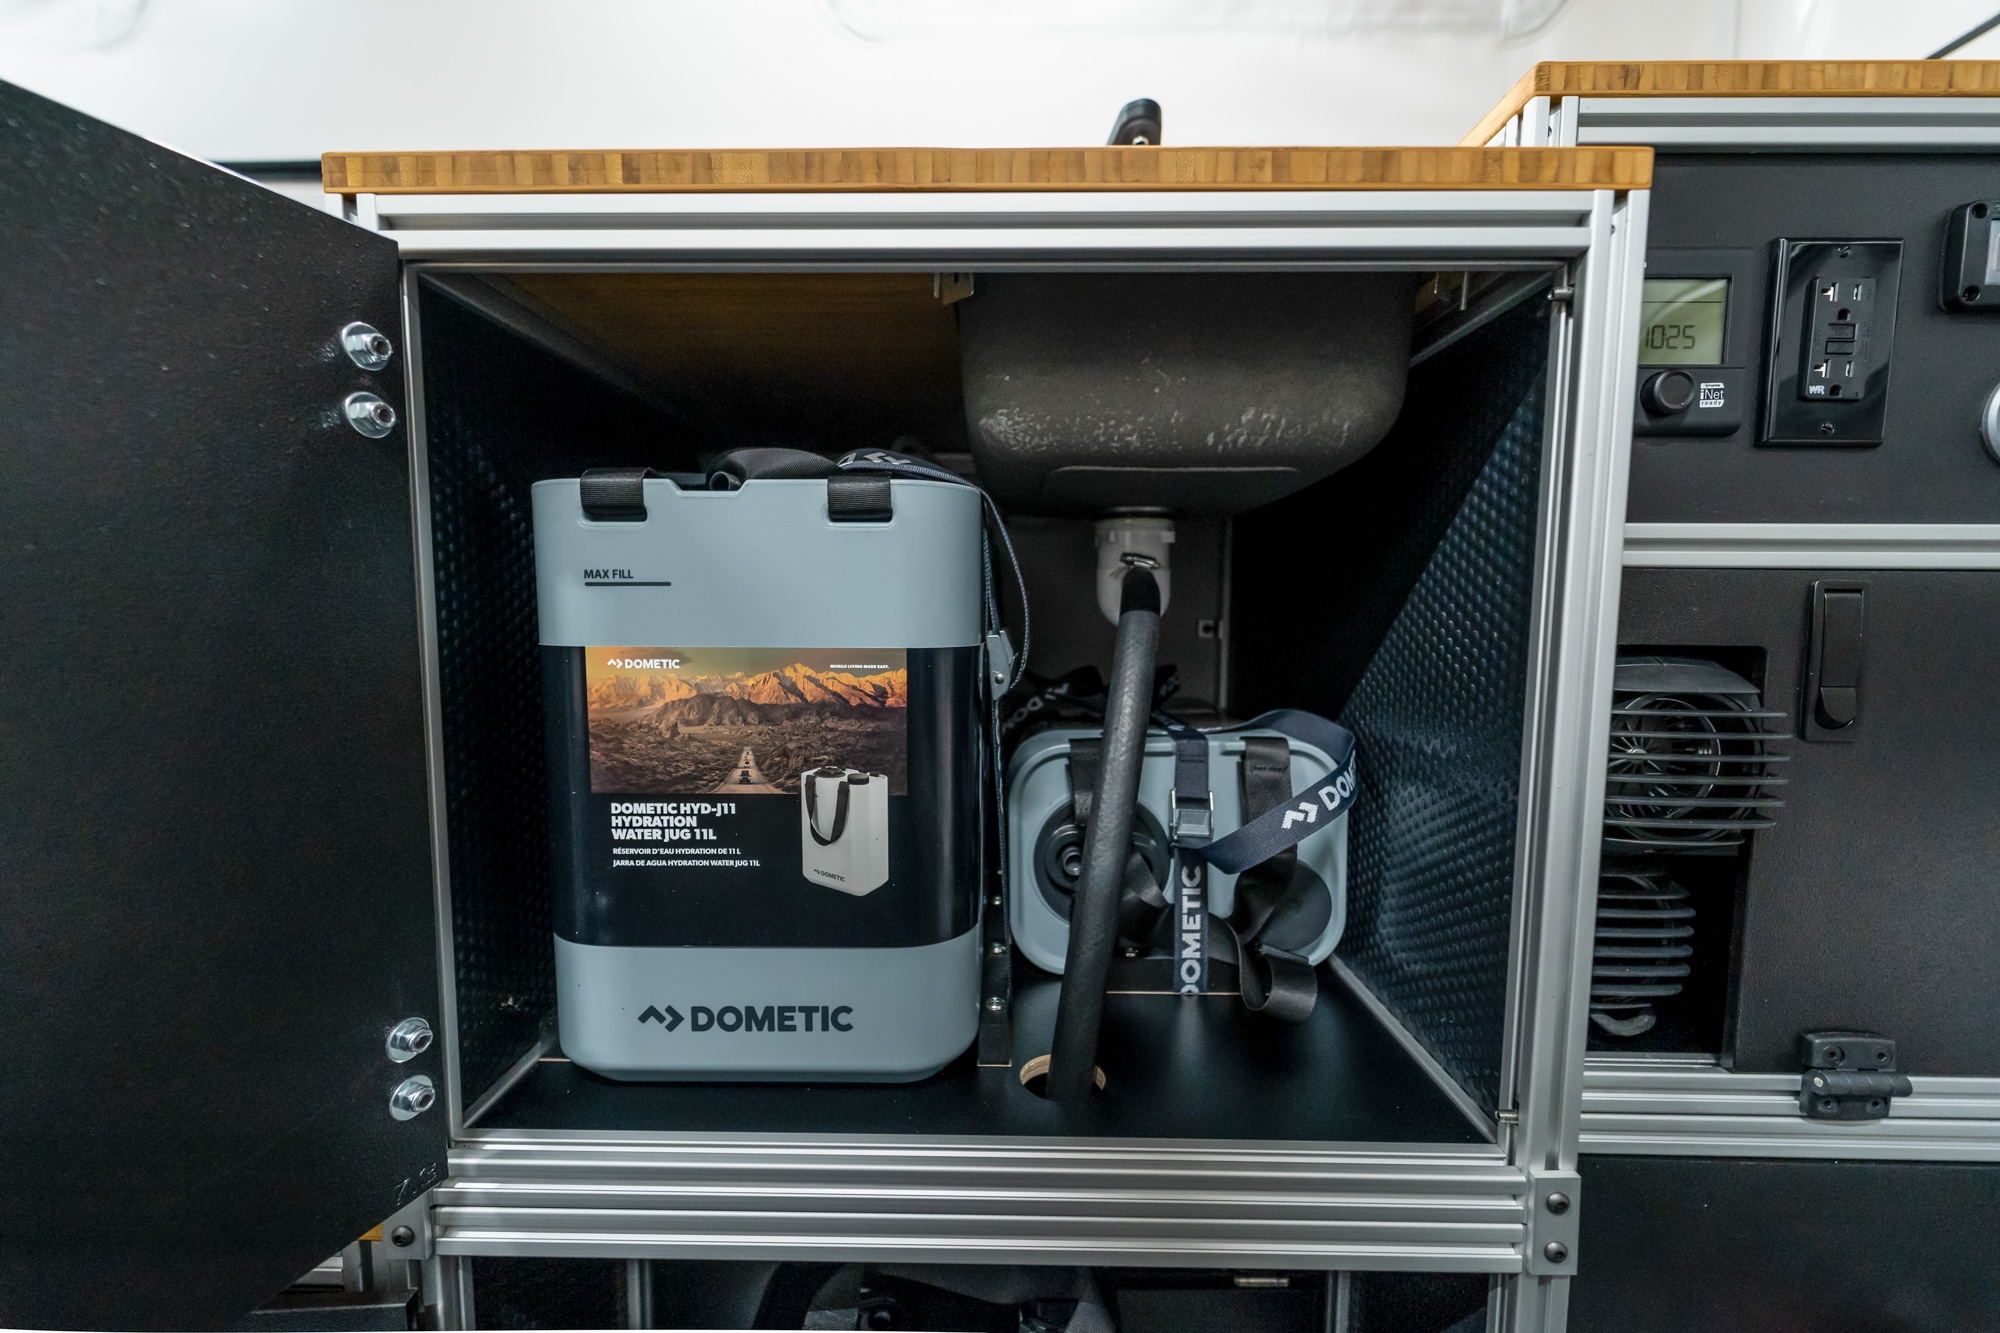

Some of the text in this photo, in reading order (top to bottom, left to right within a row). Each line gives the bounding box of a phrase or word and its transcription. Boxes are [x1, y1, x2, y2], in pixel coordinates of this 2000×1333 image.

[1700, 389, 1724, 400] iNet
[1809, 385, 1825, 395] WR
[583, 569, 634, 579] MAX FILL
[624, 658, 680, 669] DOMETIC
[610, 803, 736, 817] DOMETIC HYD-J11
[611, 816, 697, 827] HYDRATION
[611, 829, 717, 843] WATER JUG 11L
[612, 847, 651, 855] RÉSERVOIR
[612, 860, 635, 868] JARRA
[734, 860, 749, 868] JUG
[691, 1005, 854, 1032] DOMETIC
